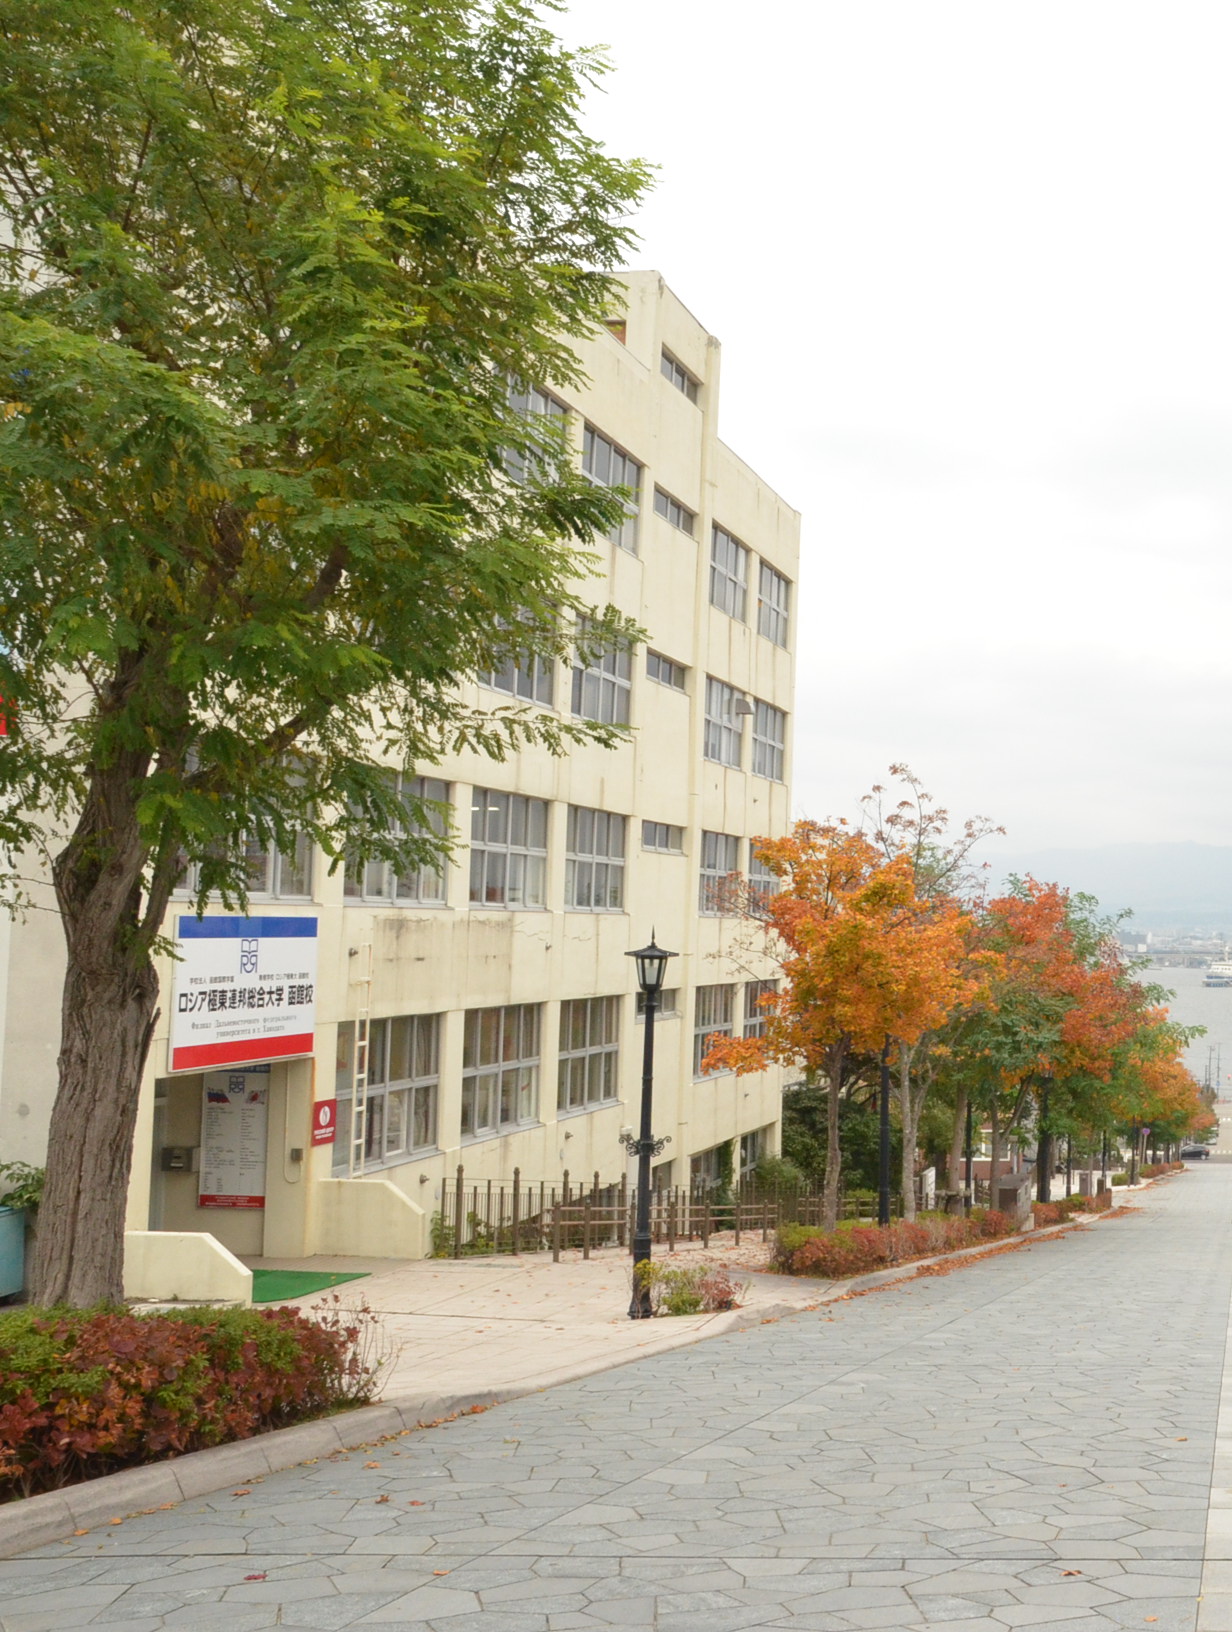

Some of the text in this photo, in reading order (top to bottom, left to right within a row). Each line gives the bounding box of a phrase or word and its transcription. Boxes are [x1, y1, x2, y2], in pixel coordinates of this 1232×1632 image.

[178, 984, 313, 1013] ロシア極東連邦総合大学 函館校
